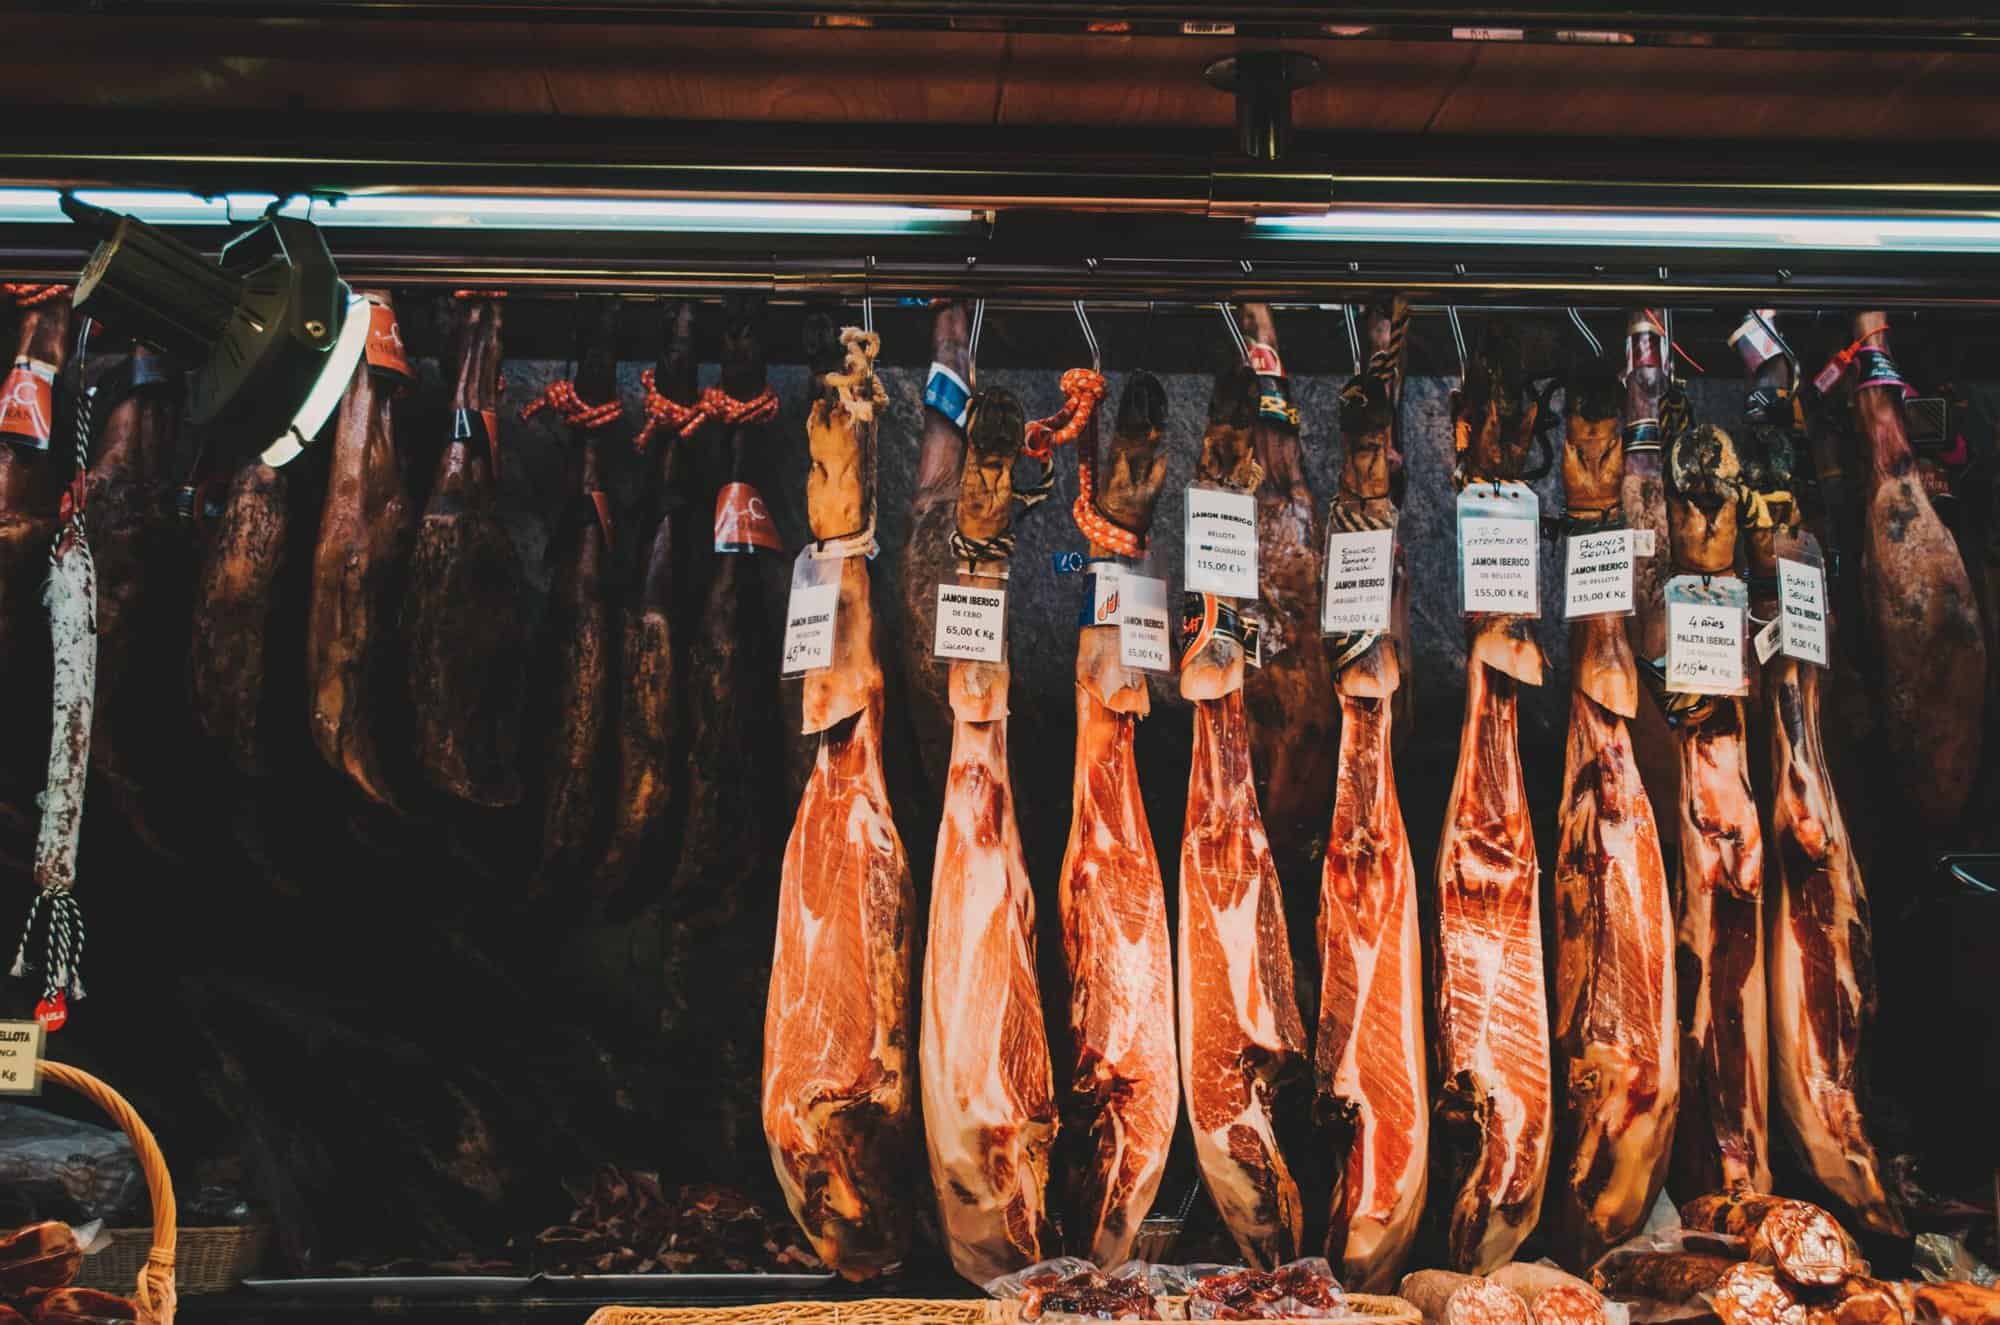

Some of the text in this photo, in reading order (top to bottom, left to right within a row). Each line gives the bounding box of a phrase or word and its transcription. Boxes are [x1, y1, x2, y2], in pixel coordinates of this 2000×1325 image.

[1192, 511, 1218, 519] JAMON
[1220, 513, 1252, 526] IBERICO
[1471, 557, 1530, 567] JAMON IBERICO
[1570, 561, 1629, 575] JAMON IBERICO
[1334, 578, 1385, 590] JAMON IBERICO
[1474, 588, 1507, 598] 155,00
[941, 593, 1000, 607] JAMON IBERICO
[952, 609, 961, 617] DE
[1688, 615, 1697, 629] 4
[946, 625, 995, 641] 65,00 € Kg
[1677, 633, 1736, 646] PALETA IBERICA
